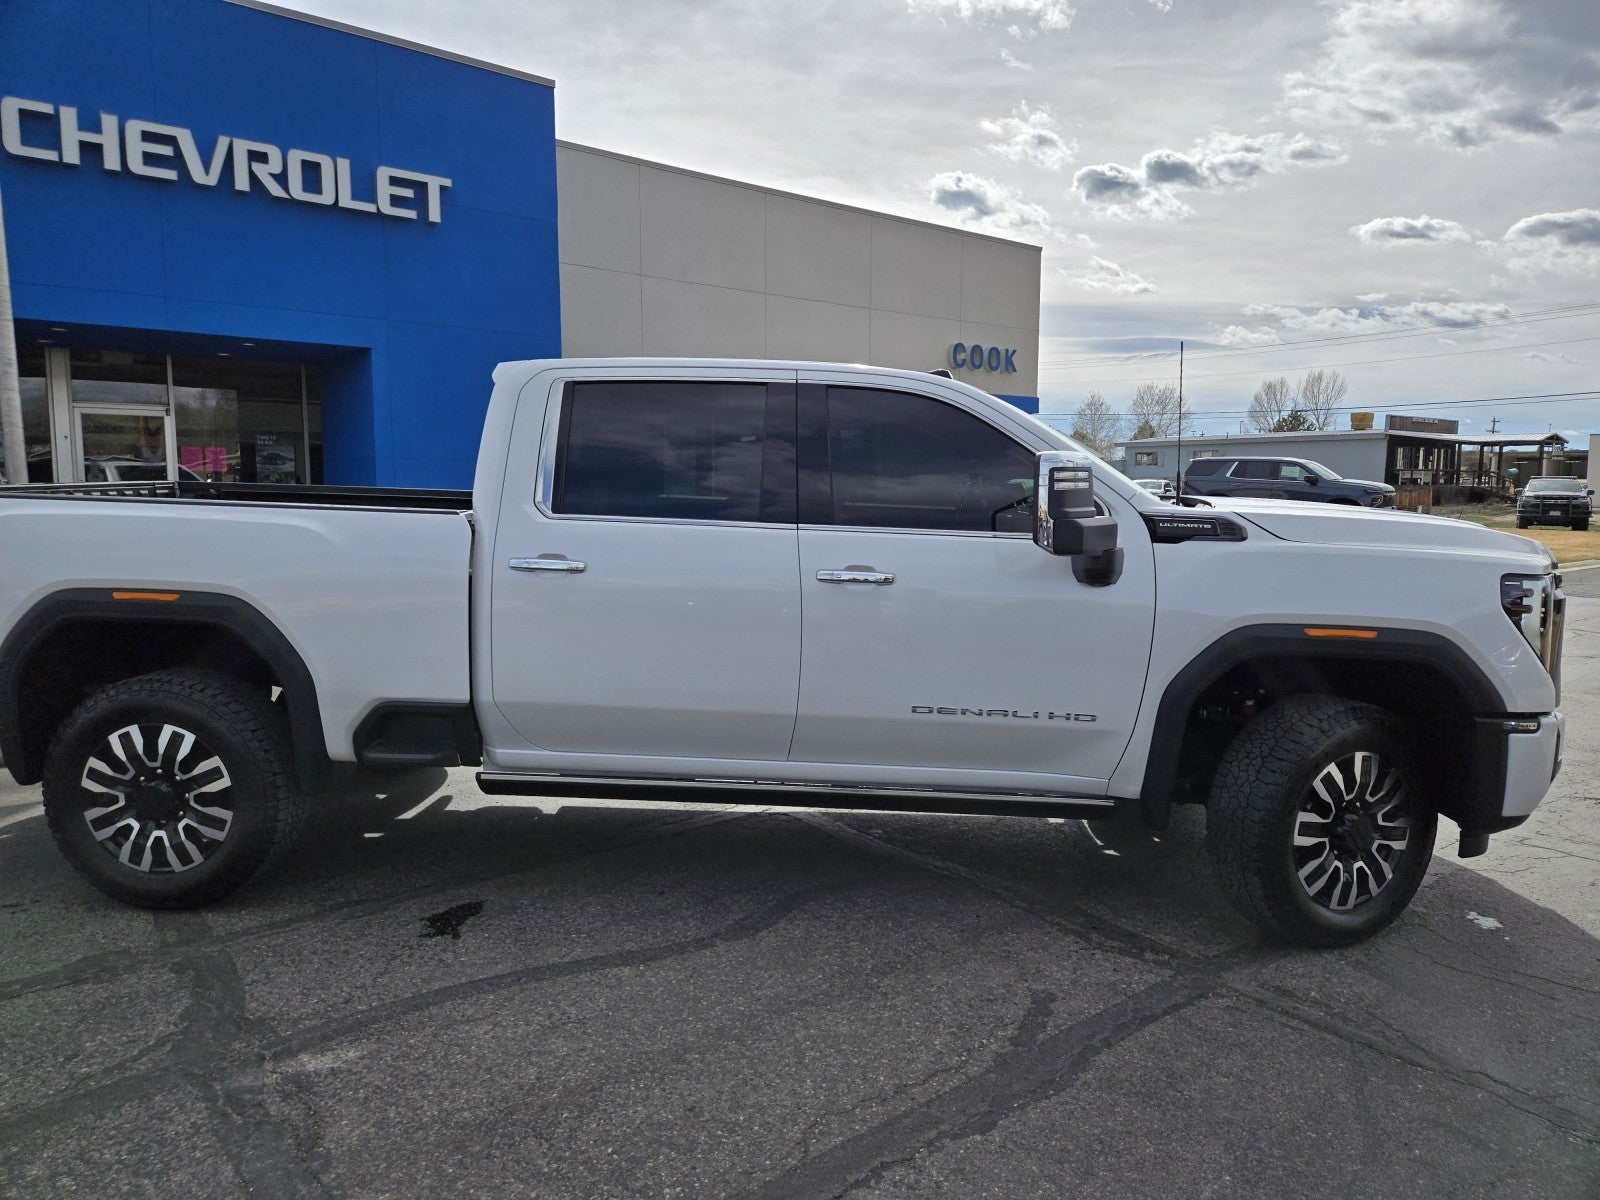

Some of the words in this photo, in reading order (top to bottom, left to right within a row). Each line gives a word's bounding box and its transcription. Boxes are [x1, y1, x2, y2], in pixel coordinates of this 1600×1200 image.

[1, 96, 452, 223] CHEVROLET
[949, 342, 1017, 373] COOK
[1159, 521, 1212, 529] ULTIMATE
[911, 705, 1039, 719] DENALI
[1048, 711, 1097, 722] HD
